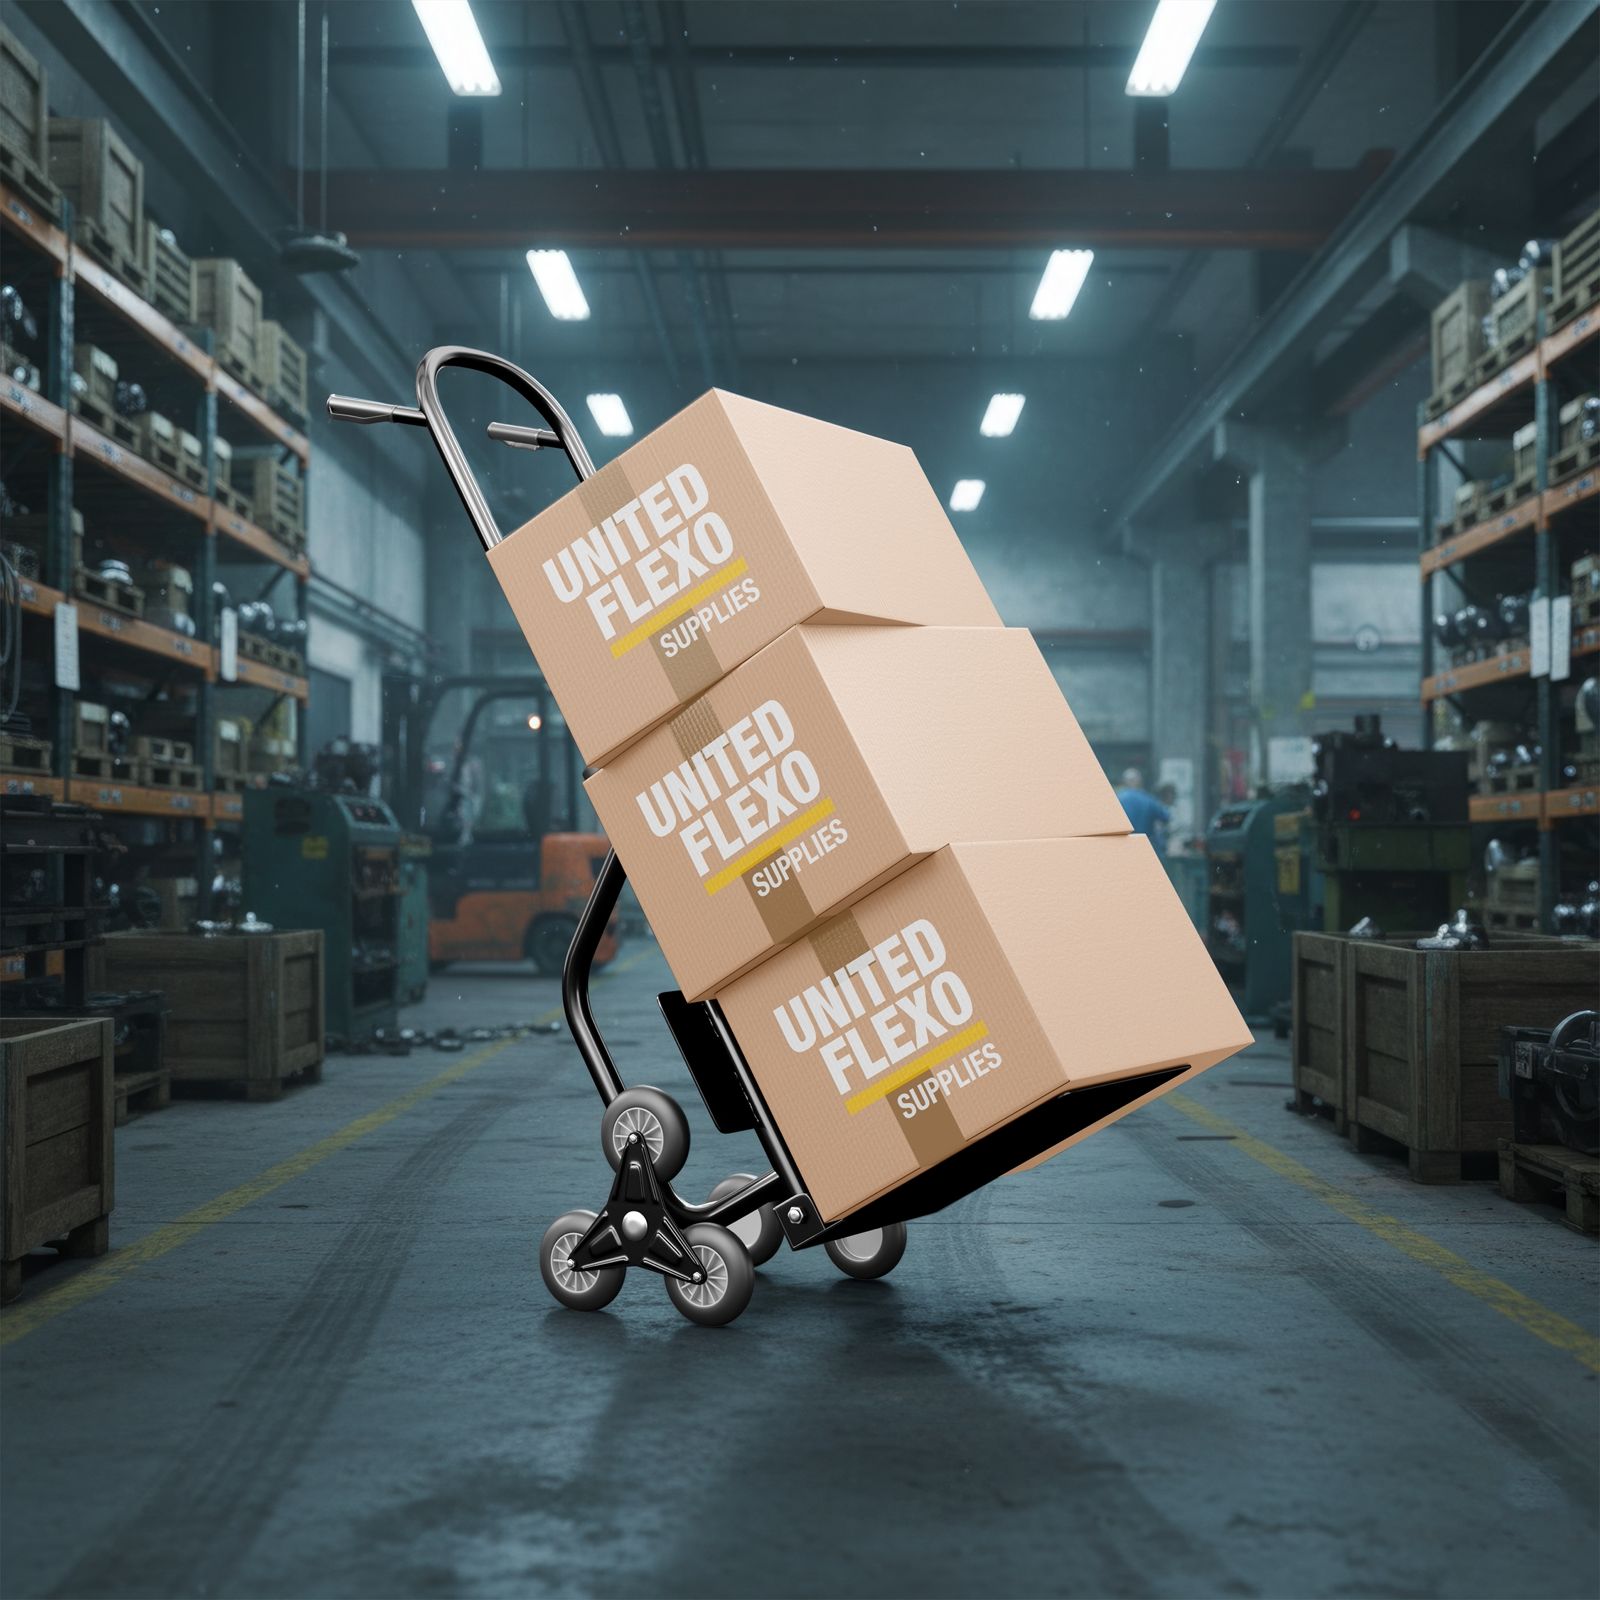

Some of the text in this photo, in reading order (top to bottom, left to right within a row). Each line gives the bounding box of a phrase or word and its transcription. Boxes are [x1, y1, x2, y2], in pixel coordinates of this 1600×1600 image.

[542, 463, 709, 603] UNITED
[585, 512, 734, 641] FLEXO
[660, 578, 760, 657] SUPPLIES
[635, 700, 795, 837] UNITED
[679, 750, 821, 877] FLEXO
[752, 819, 848, 897] SUPPLIES
[772, 919, 947, 1053] UNITED
[819, 971, 974, 1096] FLEXO
[897, 1042, 1002, 1119] SUPPLIES
